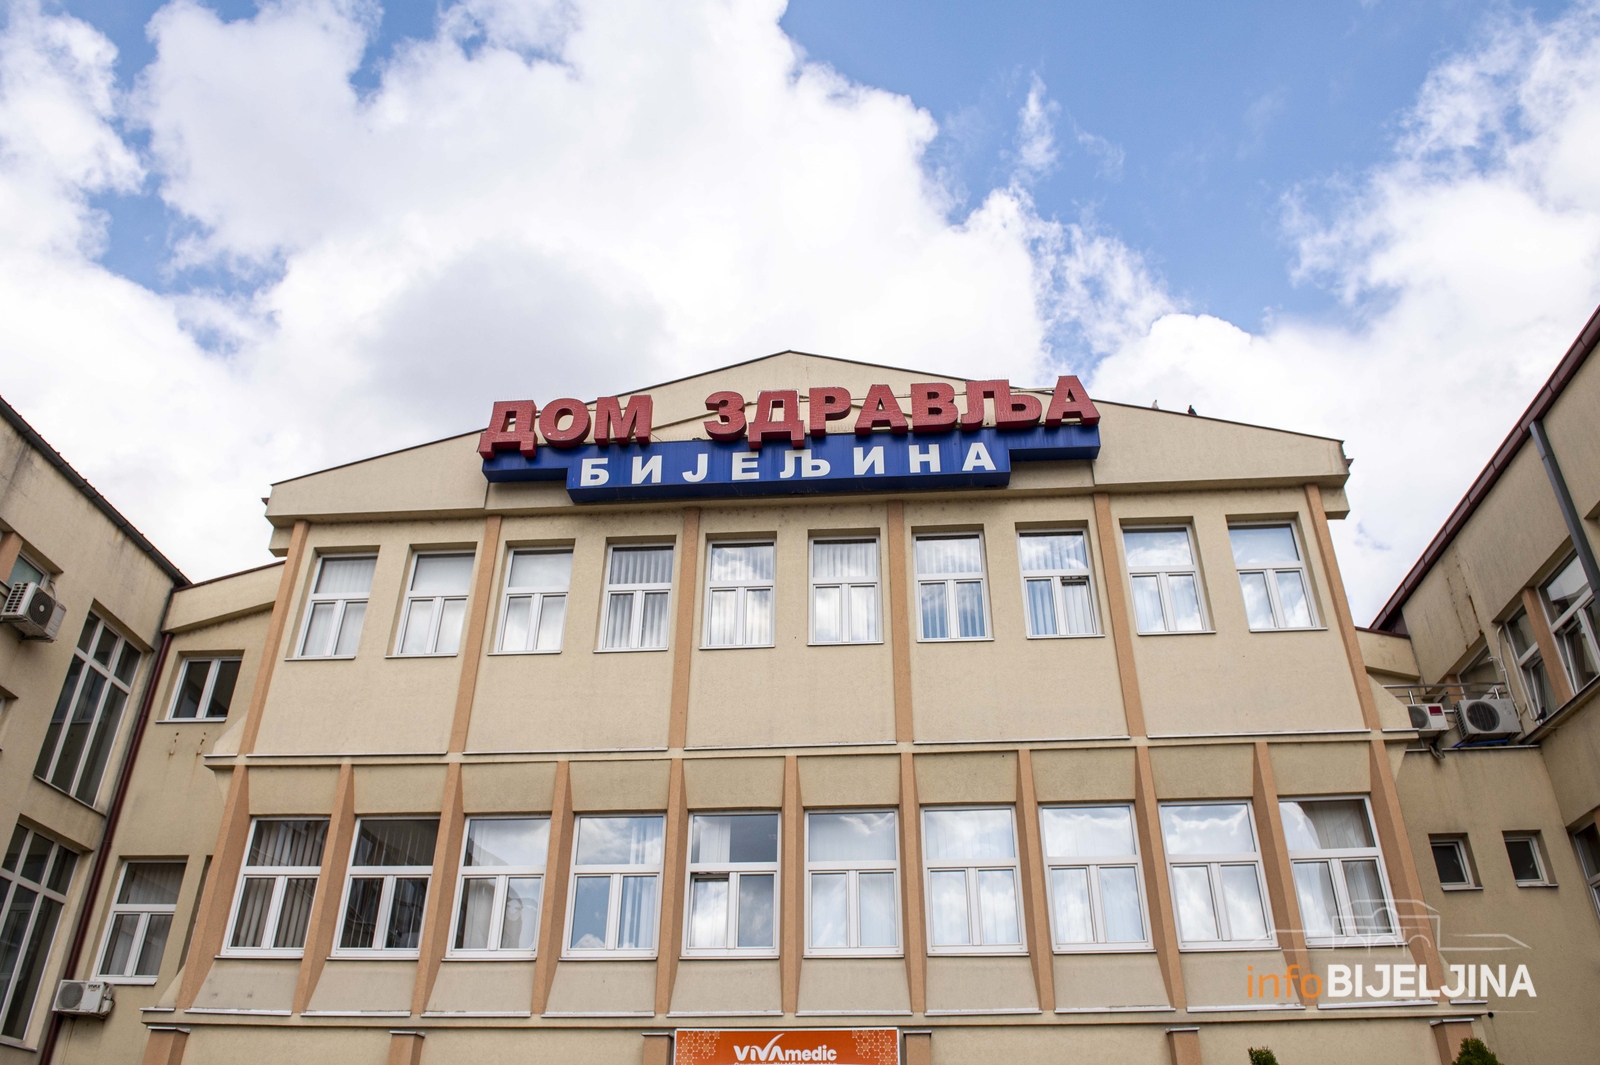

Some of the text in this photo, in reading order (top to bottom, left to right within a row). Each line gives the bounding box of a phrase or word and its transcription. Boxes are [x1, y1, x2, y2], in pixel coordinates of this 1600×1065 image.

[478, 375, 1101, 459] ДОМ ЗДРАВЉА
[579, 442, 998, 488] БИЈЕЉИНА
